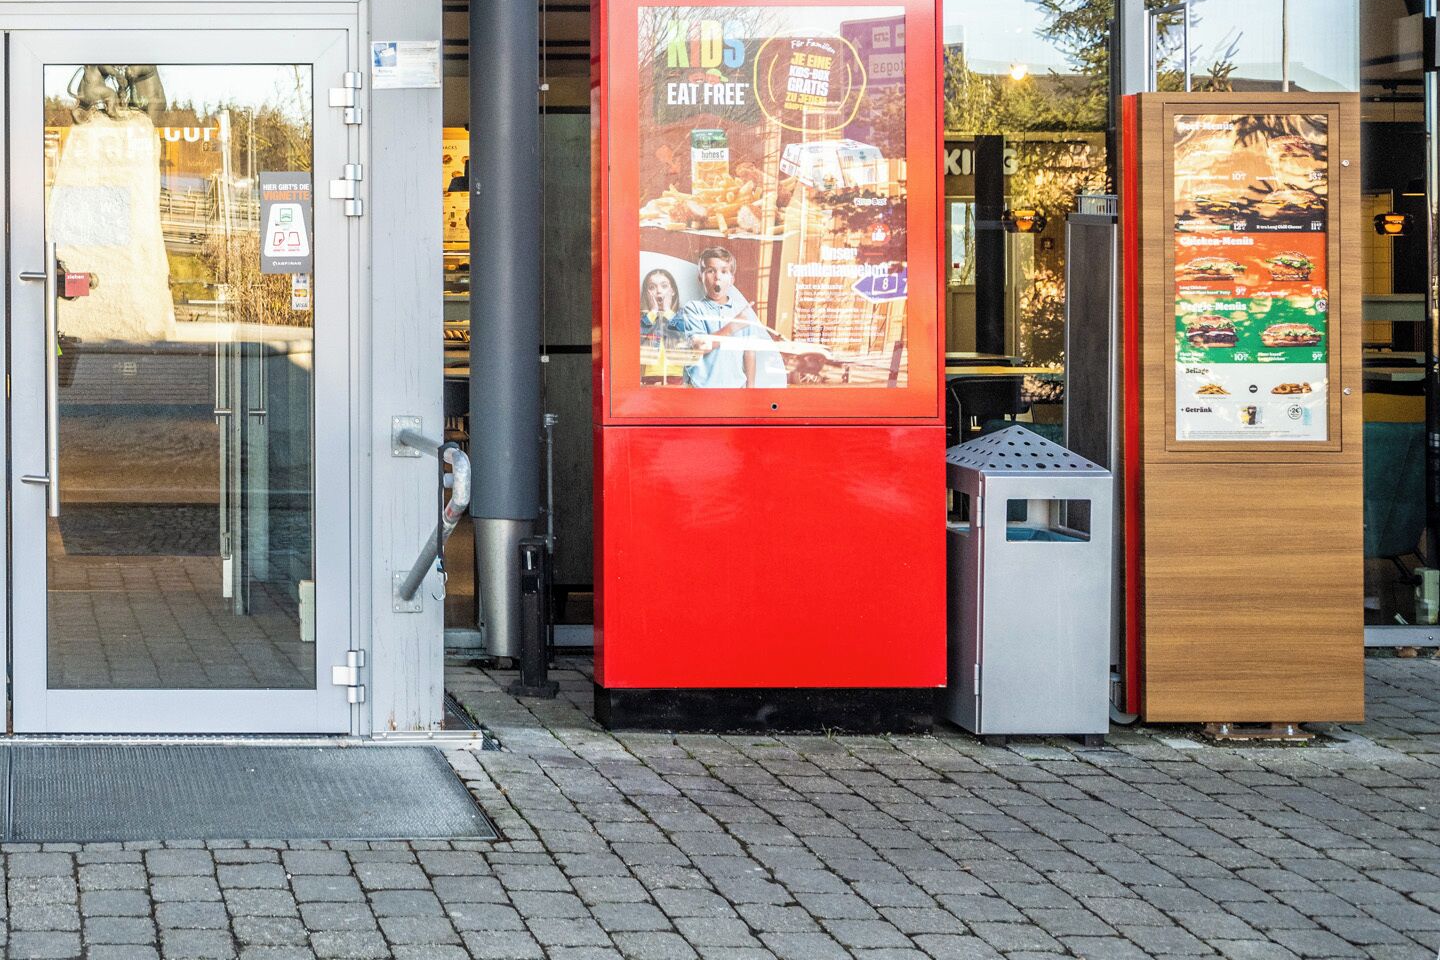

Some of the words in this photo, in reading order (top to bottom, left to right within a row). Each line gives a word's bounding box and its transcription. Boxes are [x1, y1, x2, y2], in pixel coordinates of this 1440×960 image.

[667, 18, 745, 68] KIDS
[667, 82, 699, 105] EAT
[787, 77, 829, 97] GRATIS
[944, 148, 1019, 175] KIG
[263, 191, 310, 201] VIGNETTE
